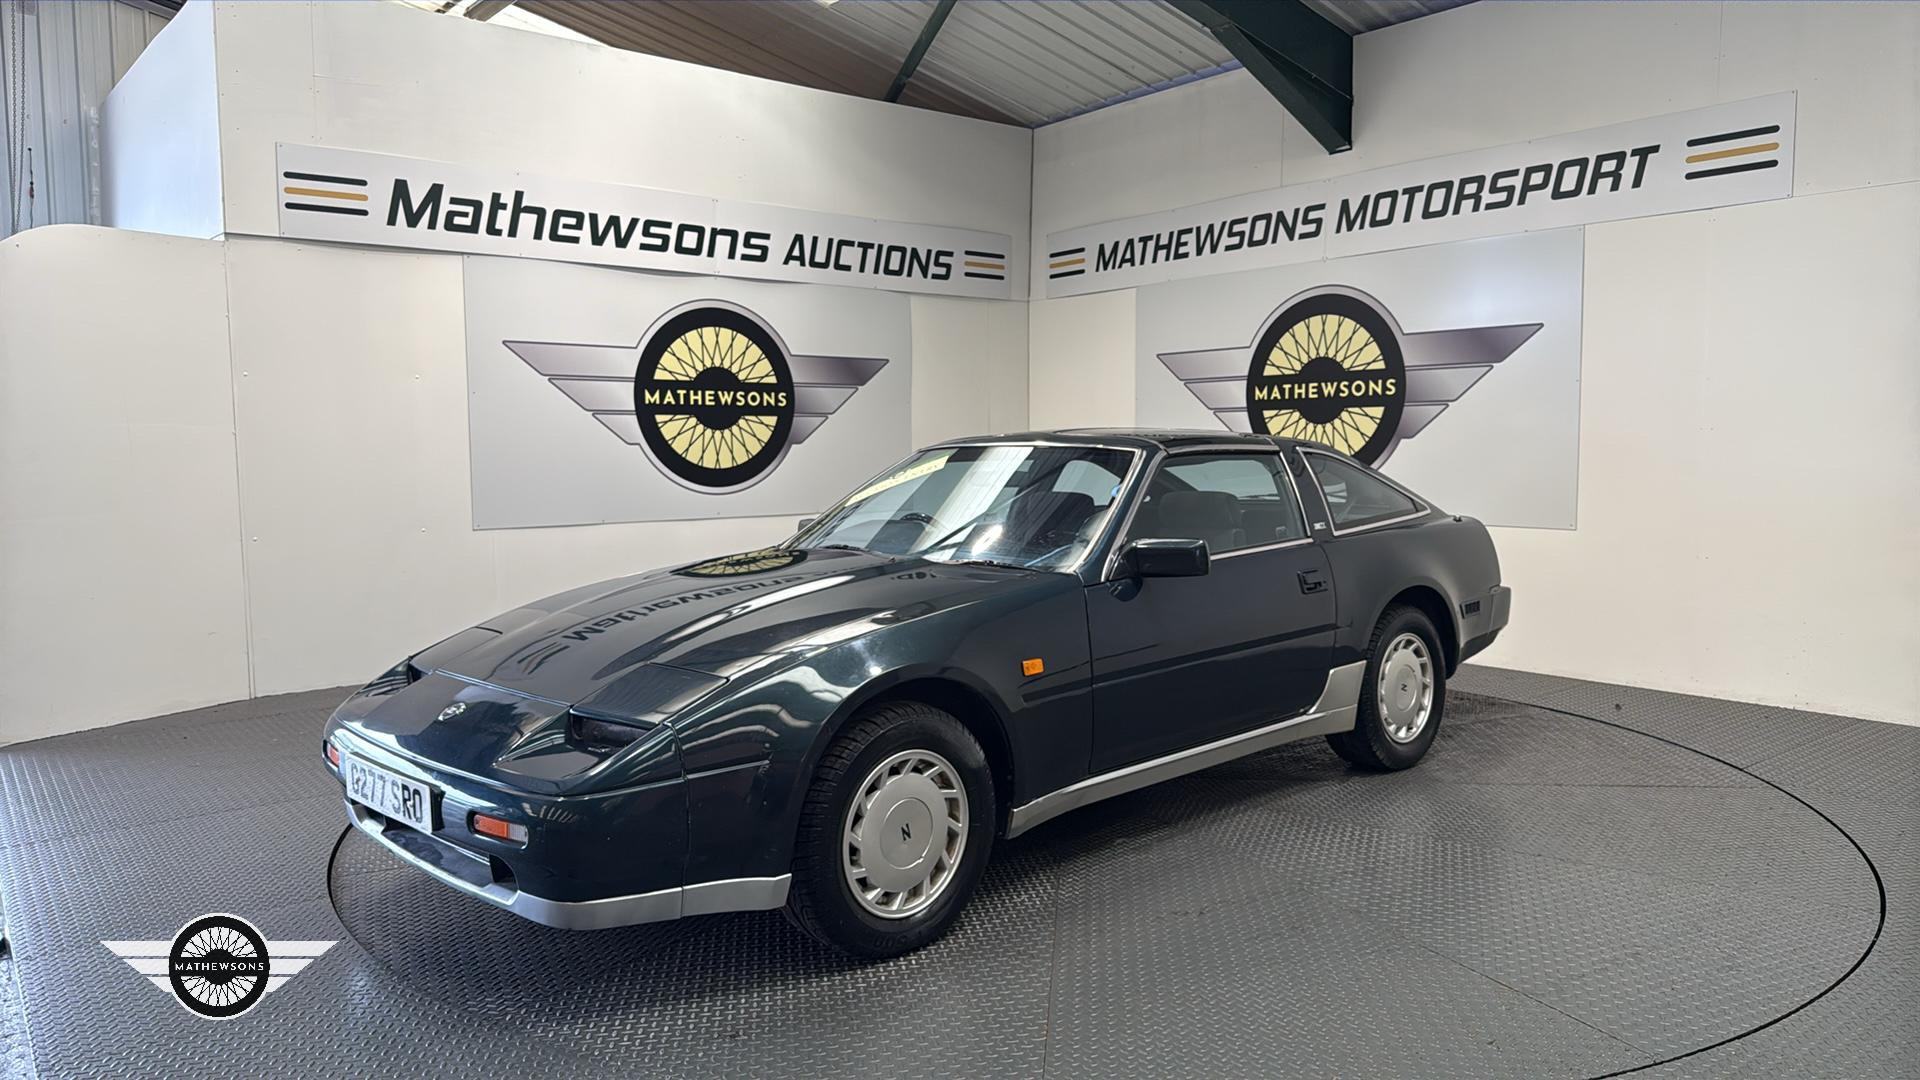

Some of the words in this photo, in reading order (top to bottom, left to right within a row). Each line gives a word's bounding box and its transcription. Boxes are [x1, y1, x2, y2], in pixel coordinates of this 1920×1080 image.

[386, 178, 771, 263] Mathewsons
[782, 233, 955, 281] AUCTIONS
[1095, 202, 1327, 273] MATHEWSONS
[1335, 144, 1661, 234] MOTORSPORT
[644, 389, 787, 407] MATHEWSONS
[1254, 378, 1396, 401] MATHEWSONS
[391, 779, 423, 824] SRO
